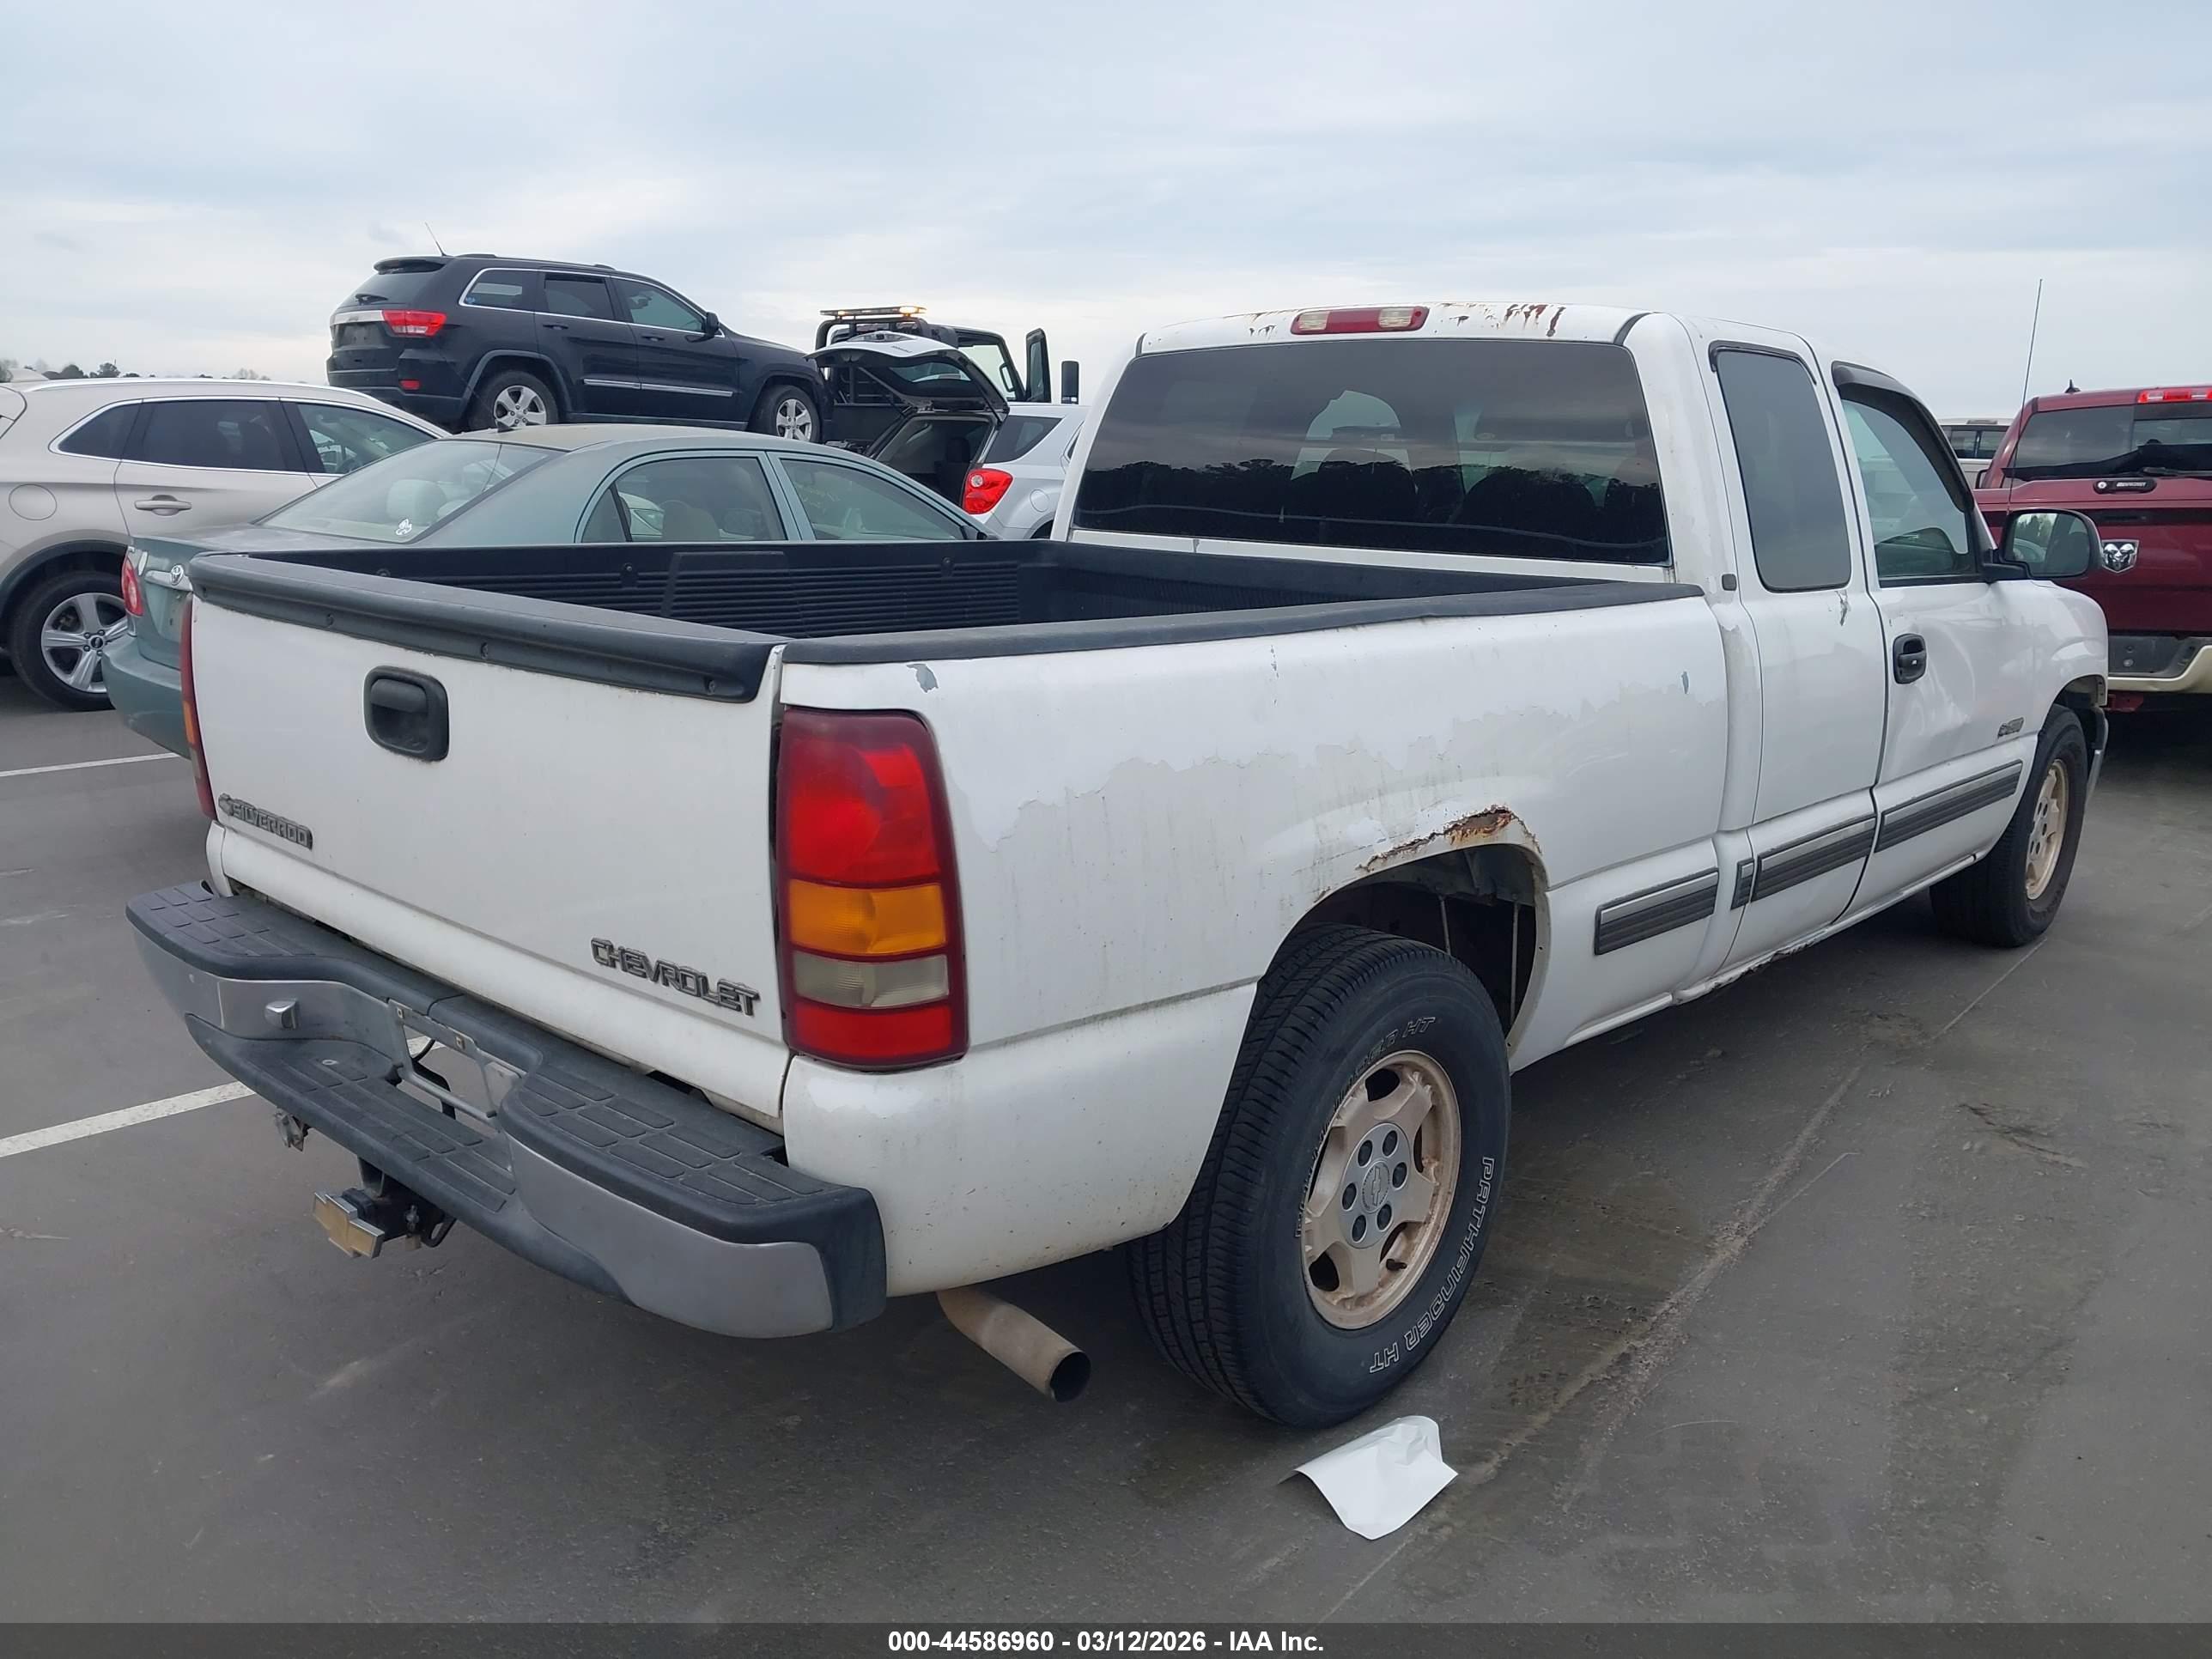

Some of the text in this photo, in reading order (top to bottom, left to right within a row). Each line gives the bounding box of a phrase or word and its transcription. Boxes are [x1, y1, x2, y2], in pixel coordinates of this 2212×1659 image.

[230, 799, 313, 850] SILVERADO
[591, 937, 761, 1017] CHEVROLET
[1402, 1017, 1436, 1038] HT
[1369, 1157, 1495, 1373] PATHFINDER HT
